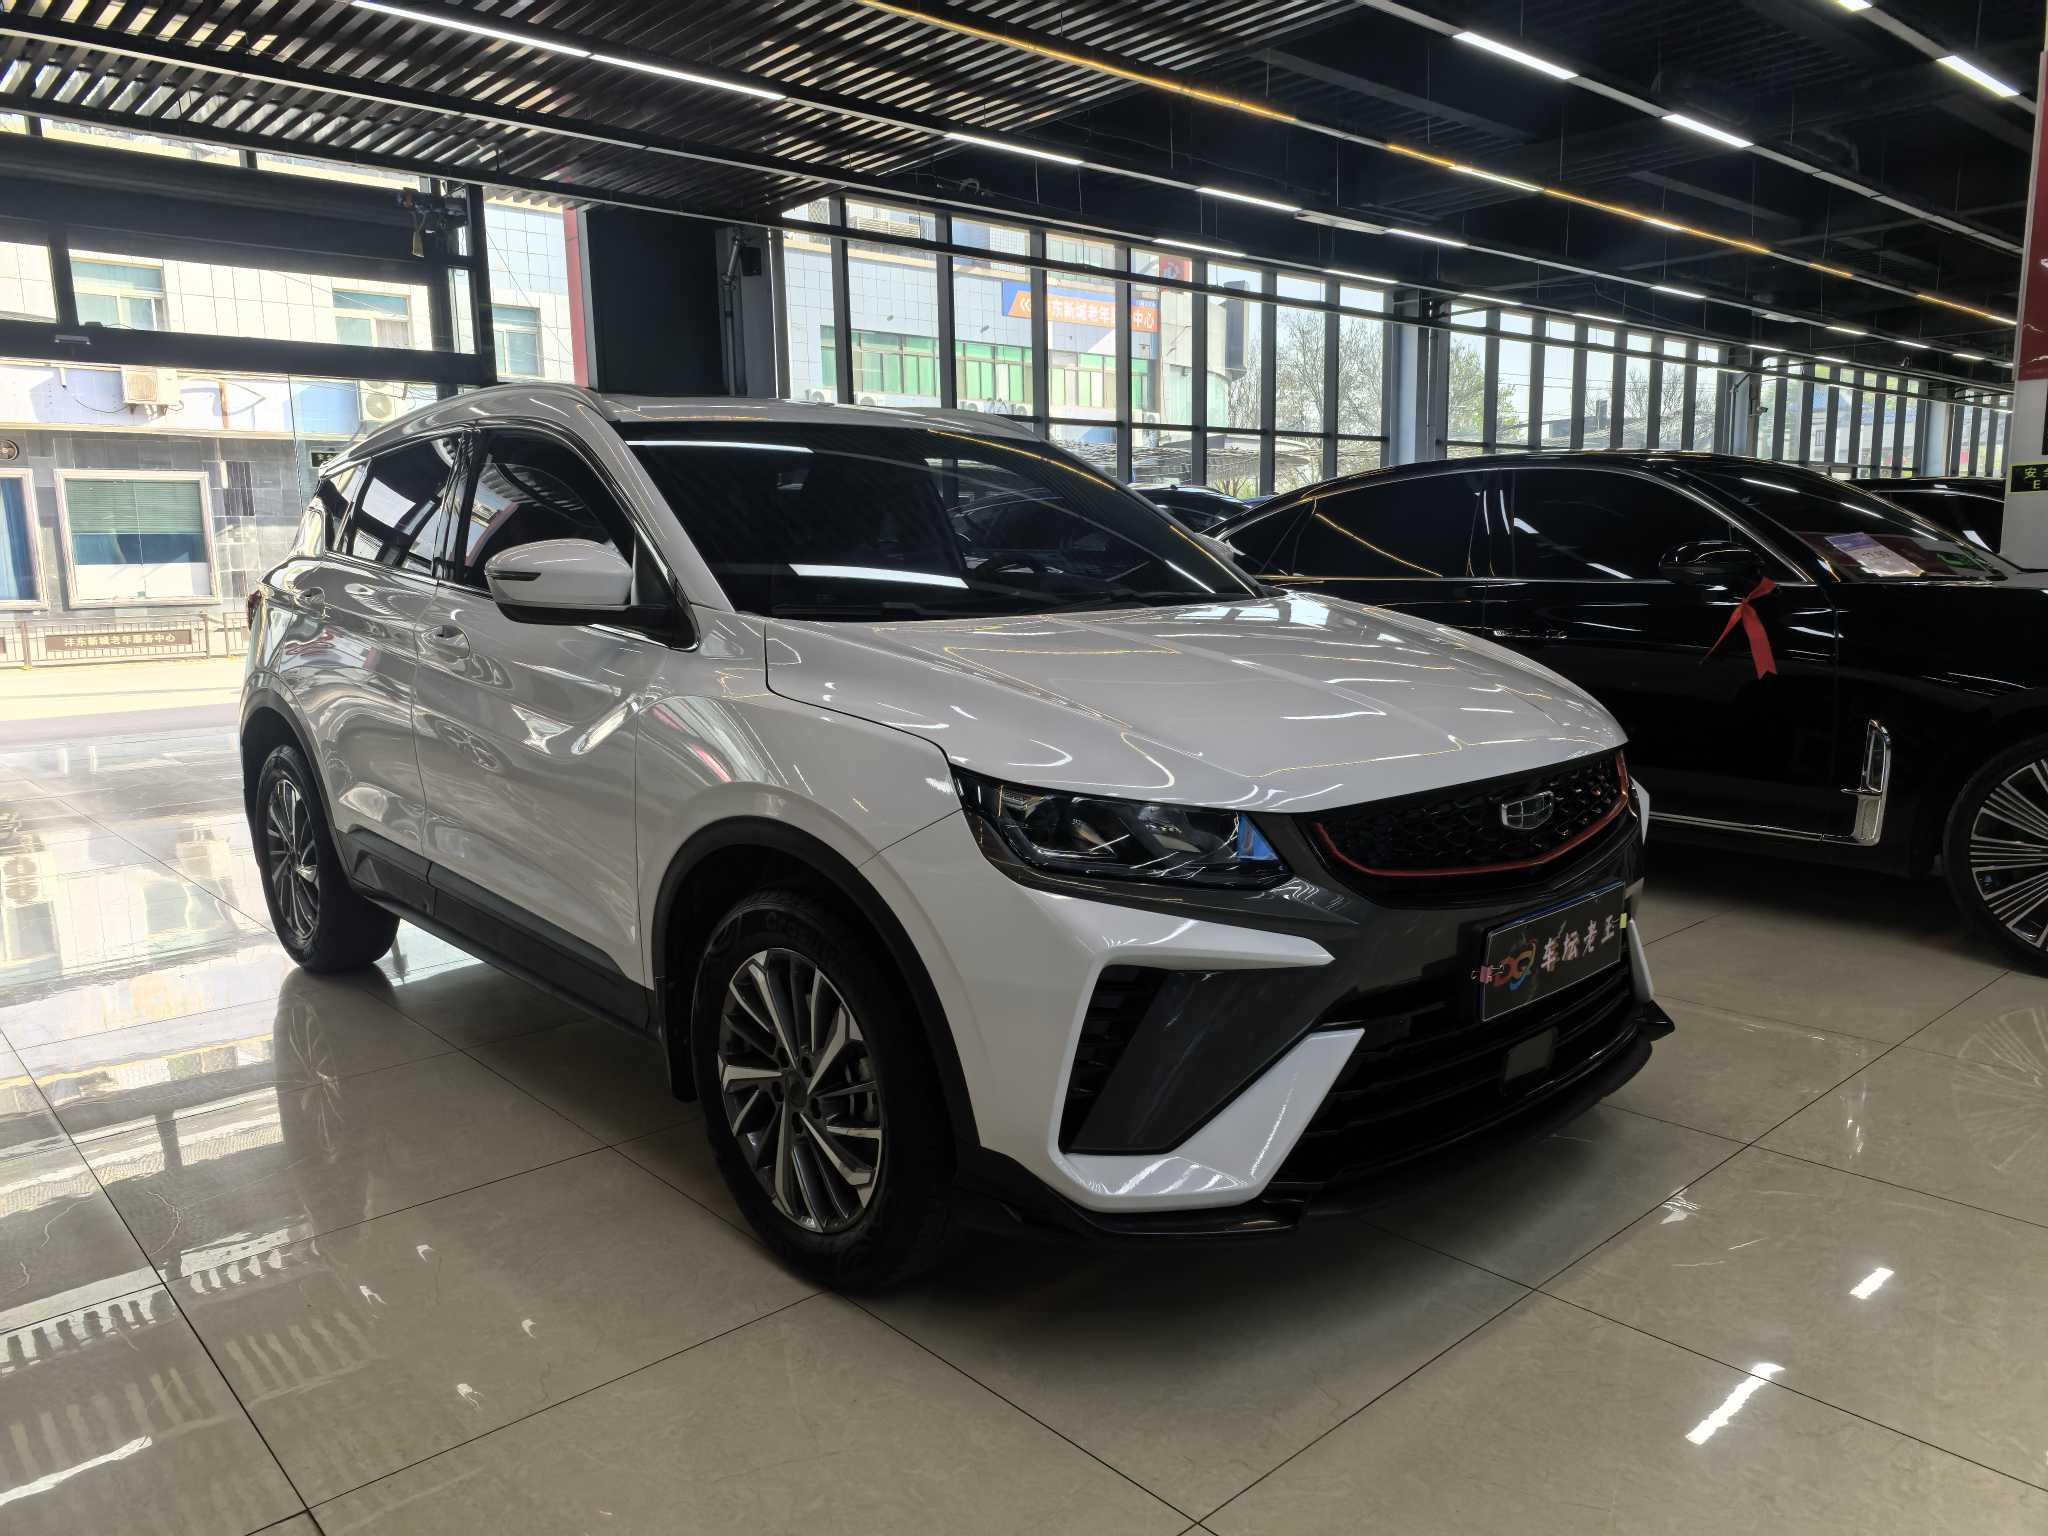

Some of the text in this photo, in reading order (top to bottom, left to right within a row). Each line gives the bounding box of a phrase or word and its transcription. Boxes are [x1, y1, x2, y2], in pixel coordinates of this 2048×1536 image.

[1047, 298, 1155, 329] 东新城老年中心
